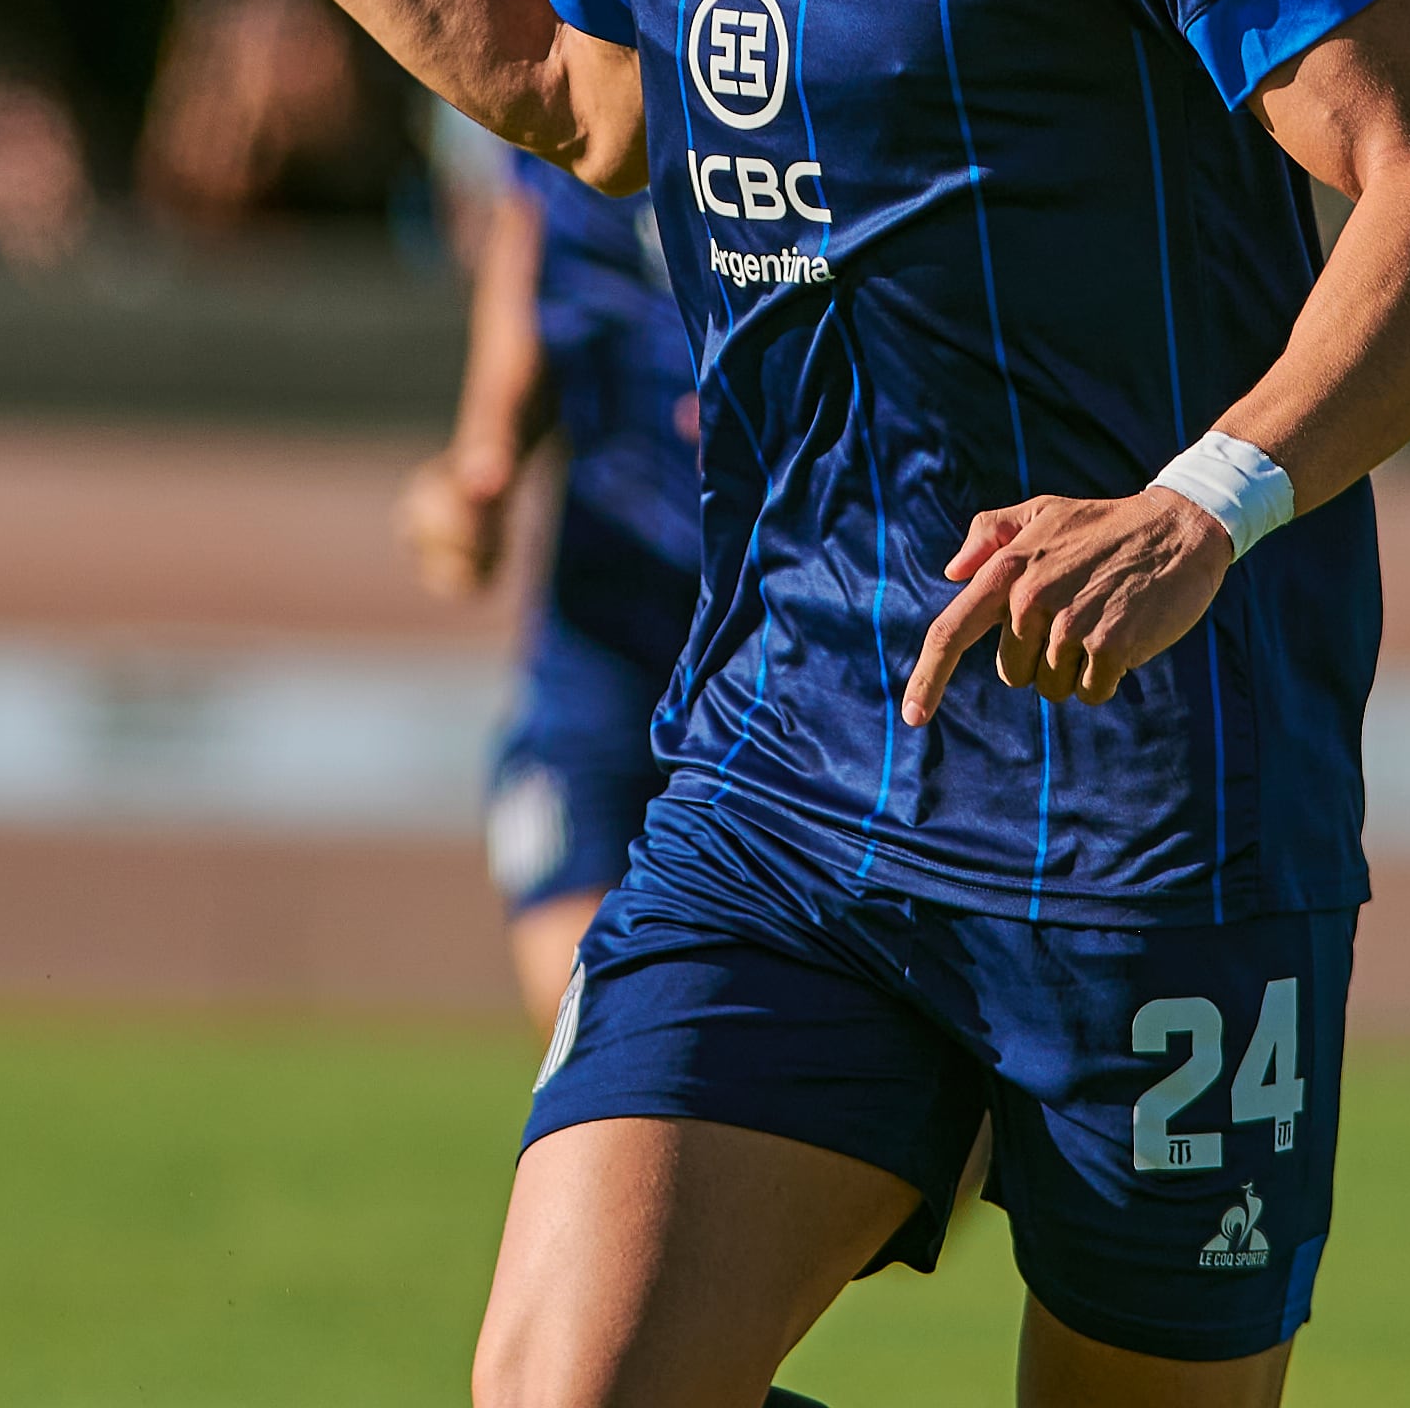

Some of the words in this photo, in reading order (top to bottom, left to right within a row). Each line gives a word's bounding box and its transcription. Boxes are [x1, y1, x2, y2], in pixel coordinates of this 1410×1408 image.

[687, 149, 832, 223] ICBC
[710, 237, 831, 287] Argentina
[1132, 977, 1304, 1171] 24
[1199, 1252, 1213, 1266] LE
